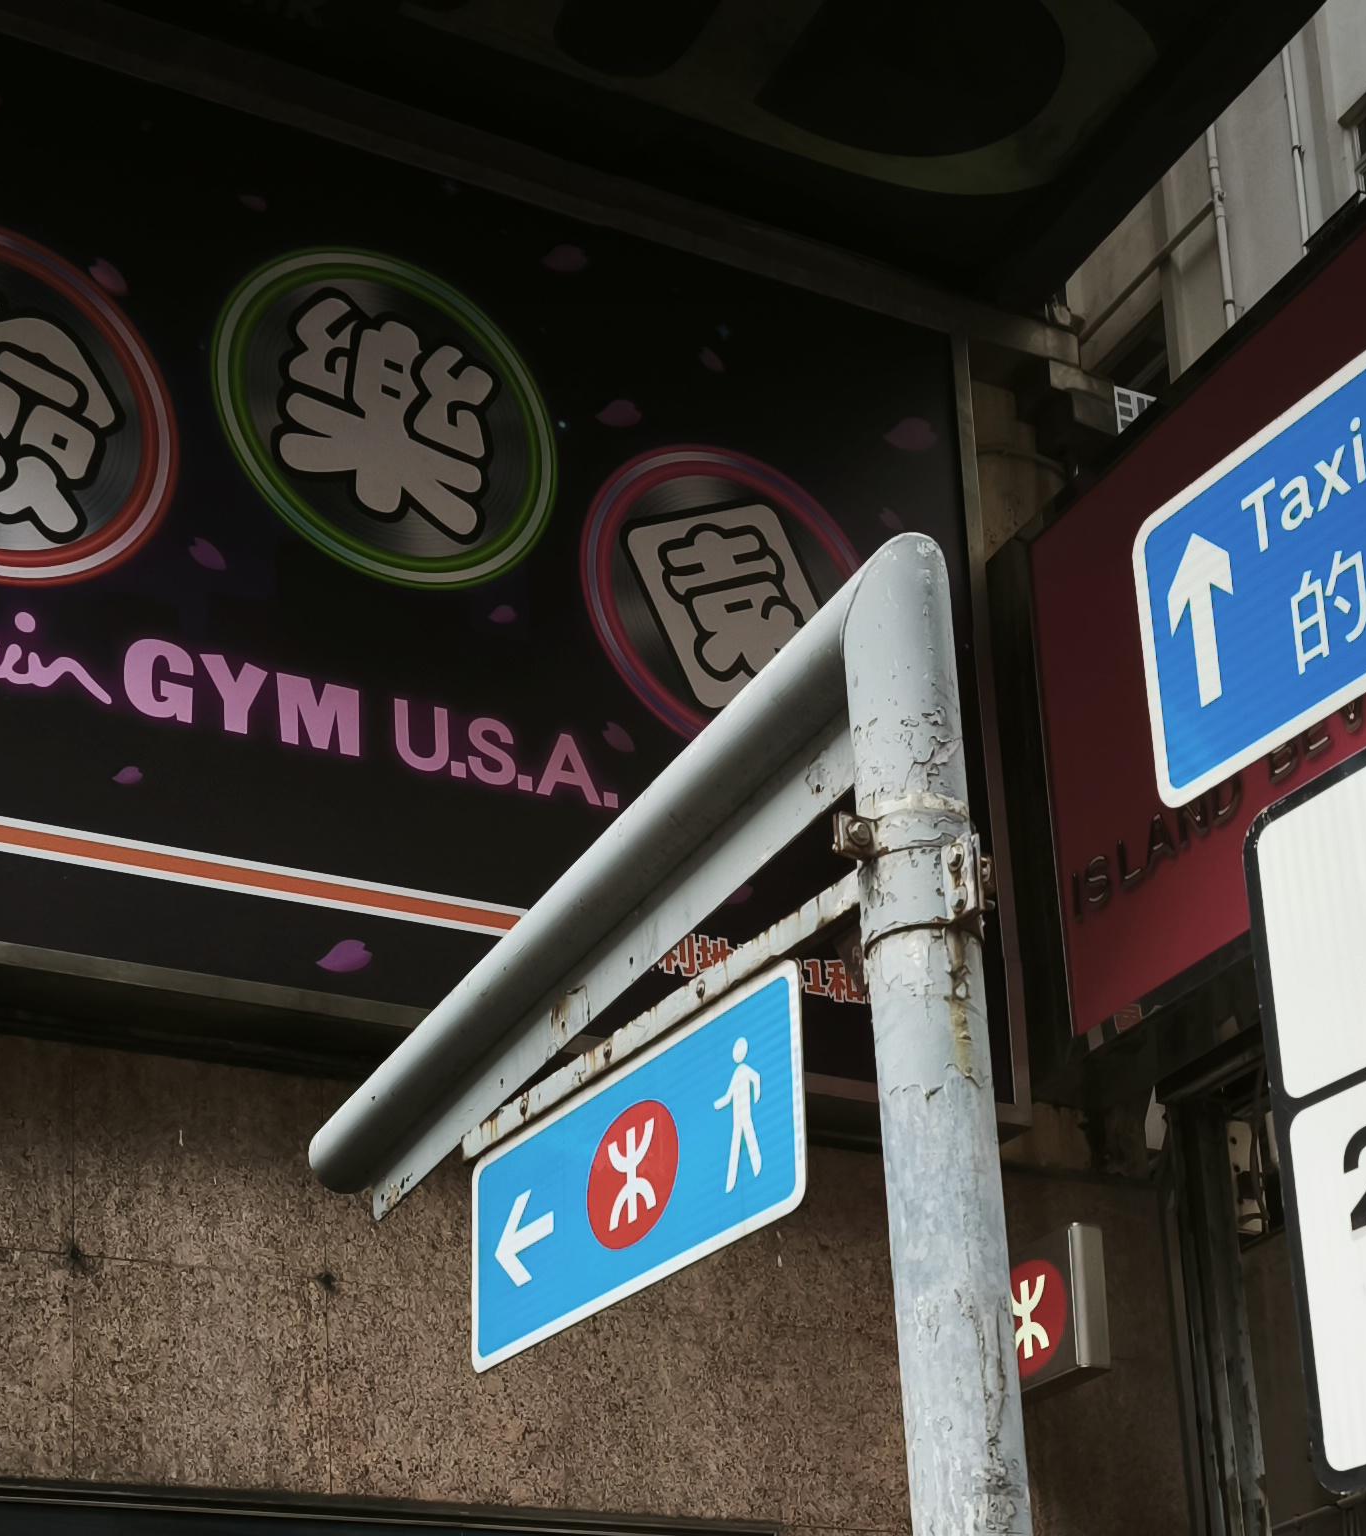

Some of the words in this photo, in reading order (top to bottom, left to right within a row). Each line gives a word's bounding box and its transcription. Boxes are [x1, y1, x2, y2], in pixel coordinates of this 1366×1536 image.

[1240, 416, 1366, 553] Taxi
[120, 636, 361, 758] GYM
[391, 697, 620, 810] U.S.A.
